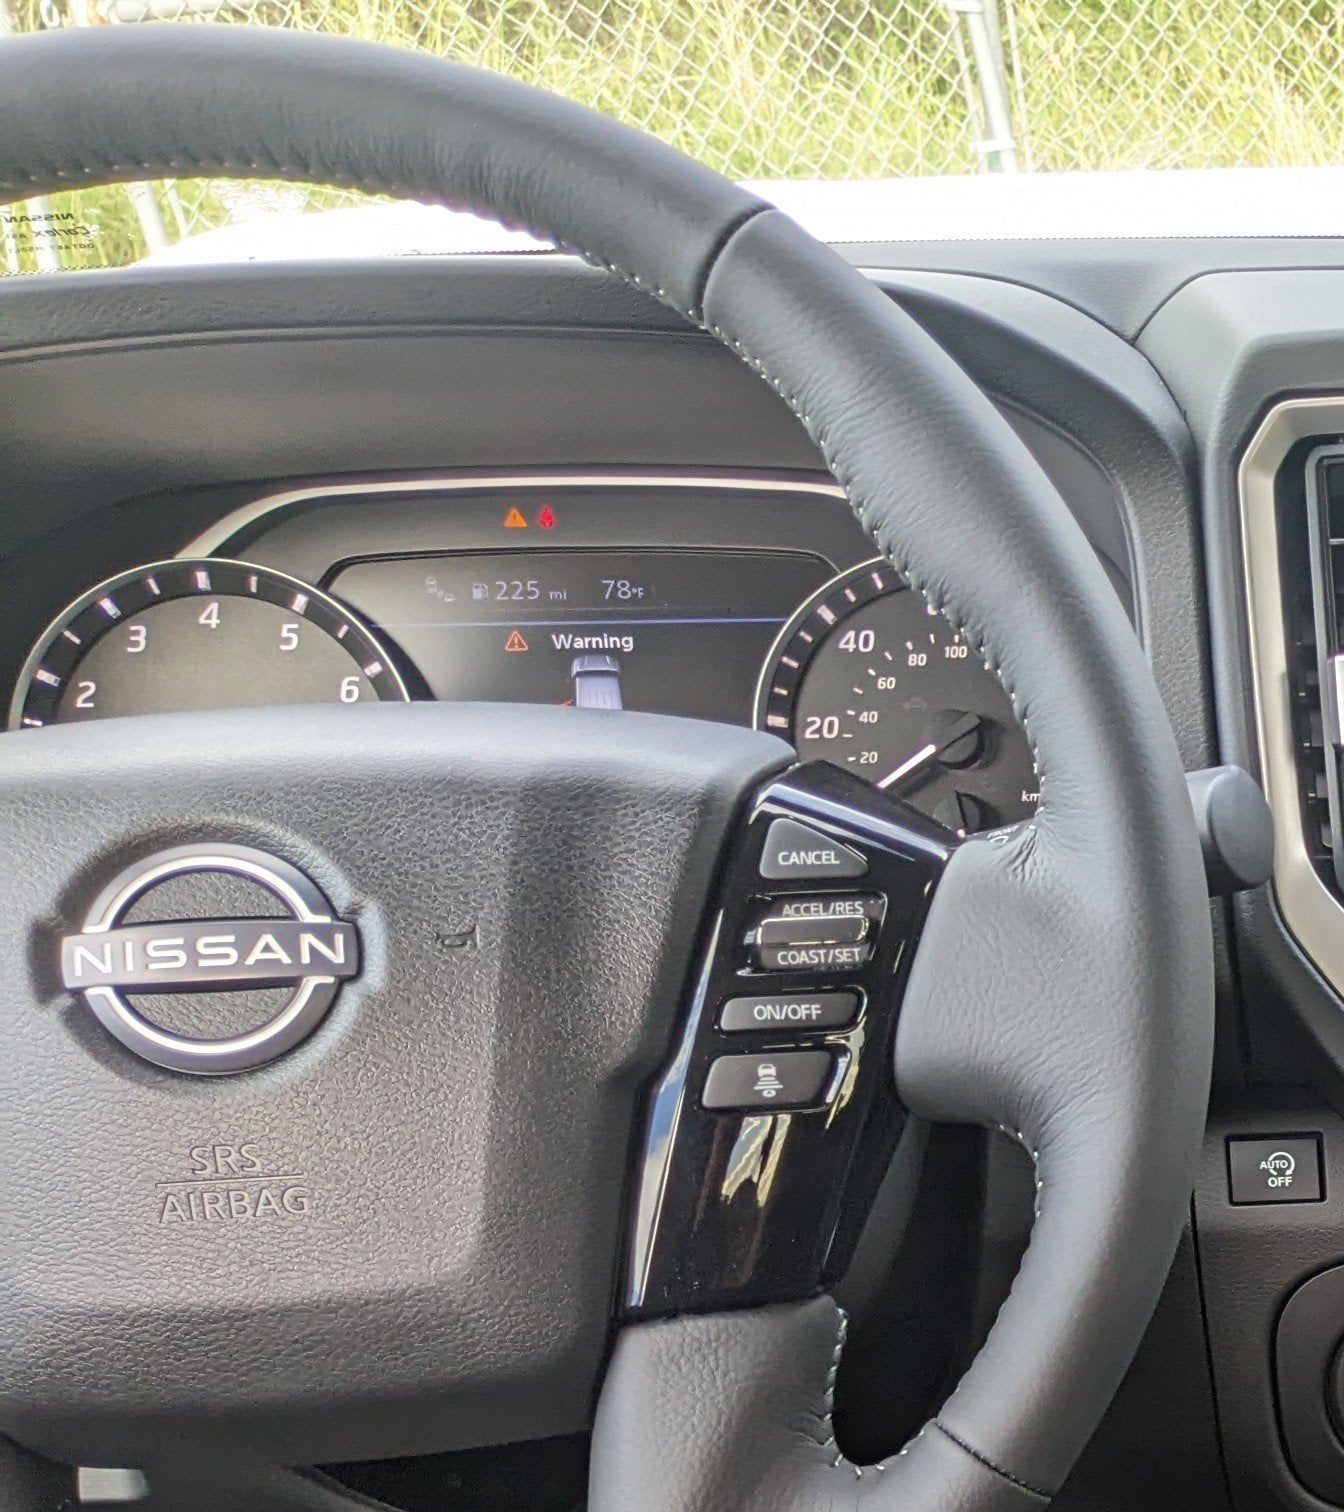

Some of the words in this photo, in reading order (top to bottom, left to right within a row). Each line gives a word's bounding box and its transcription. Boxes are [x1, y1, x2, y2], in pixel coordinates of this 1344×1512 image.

[494, 581, 540, 601] 225
[549, 589, 568, 601] mi
[199, 602, 221, 629] 4
[126, 625, 148, 653] 3
[279, 623, 300, 651] 5
[551, 633, 634, 652] Warning
[838, 630, 875, 653] 40
[907, 654, 927, 667] 80
[944, 646, 968, 659] 100
[339, 676, 360, 703] 6
[877, 677, 896, 690] 60
[75, 681, 96, 708] 2
[859, 710, 878, 724] 40
[804, 716, 840, 740] 20
[860, 751, 878, 765] 20
[778, 850, 841, 866] CANCEL
[782, 901, 864, 917] ACCEL/RES
[73, 933, 346, 977] NISSAN
[777, 949, 862, 966] COAST/SET
[753, 1004, 822, 1021] ON/OFF
[190, 1143, 262, 1175] SRS
[1259, 1159, 1289, 1170] AUTO
[1267, 1176, 1293, 1188] OFF
[159, 1187, 310, 1224] AIRBAG
